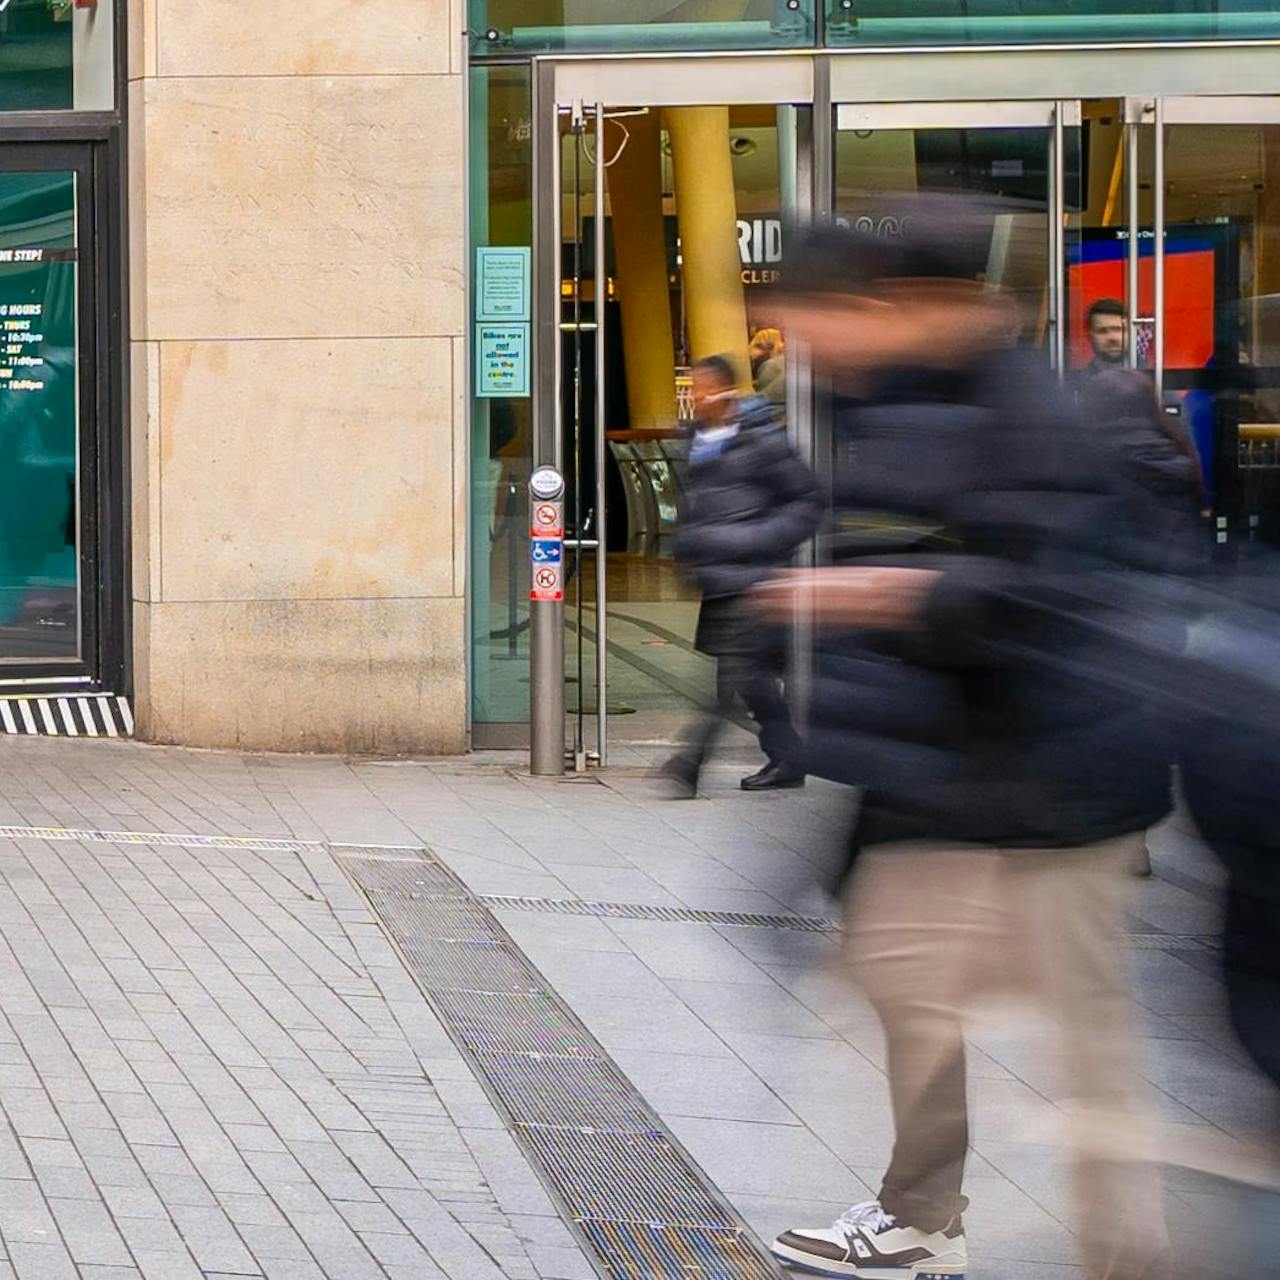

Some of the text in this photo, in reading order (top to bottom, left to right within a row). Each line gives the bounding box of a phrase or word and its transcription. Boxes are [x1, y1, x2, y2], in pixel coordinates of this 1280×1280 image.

[14, 249, 43, 261] STEP!
[8, 304, 42, 316] HOURS
[483, 331, 506, 339] Bikes
[495, 342, 510, 351] not
[485, 351, 519, 359] allowed
